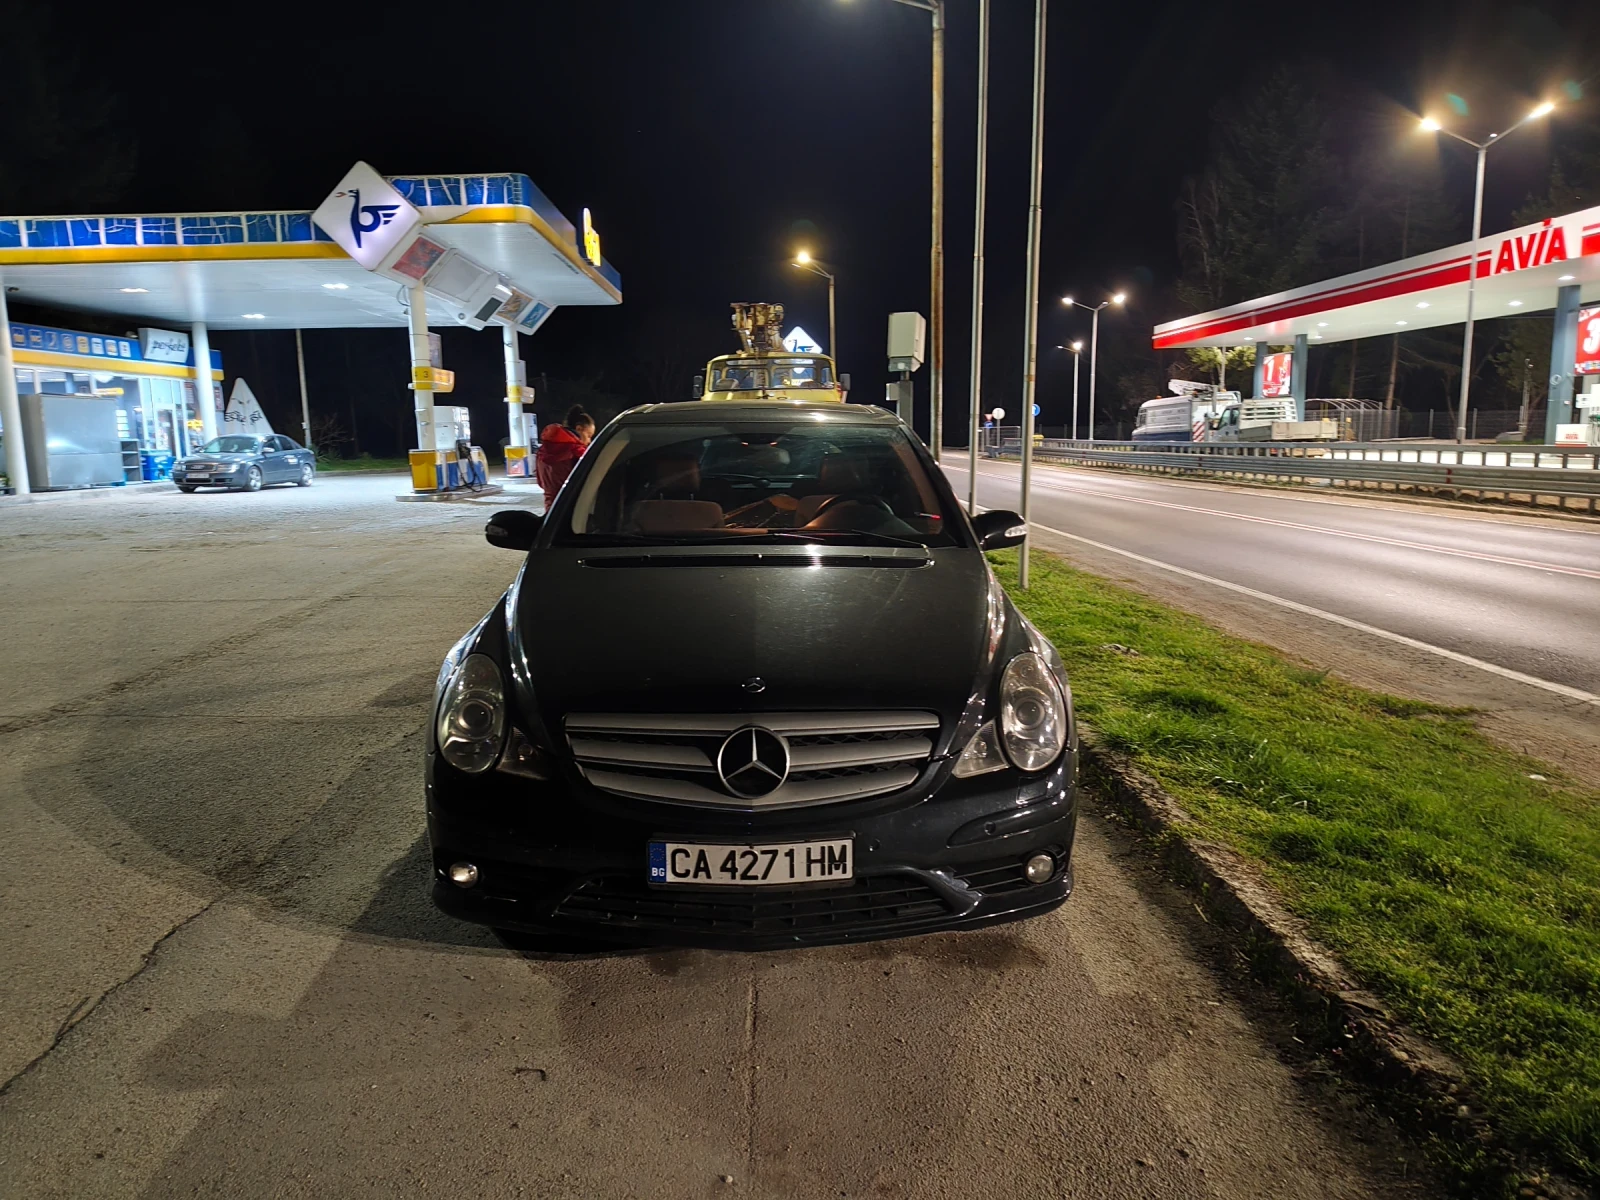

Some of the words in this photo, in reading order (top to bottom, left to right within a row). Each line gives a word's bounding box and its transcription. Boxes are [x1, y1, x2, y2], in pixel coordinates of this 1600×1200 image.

[1494, 217, 1567, 275] AVIA
[651, 867, 665, 877] BG
[671, 848, 712, 880] CA
[719, 848, 795, 881] 4271
[806, 844, 848, 877] HM
